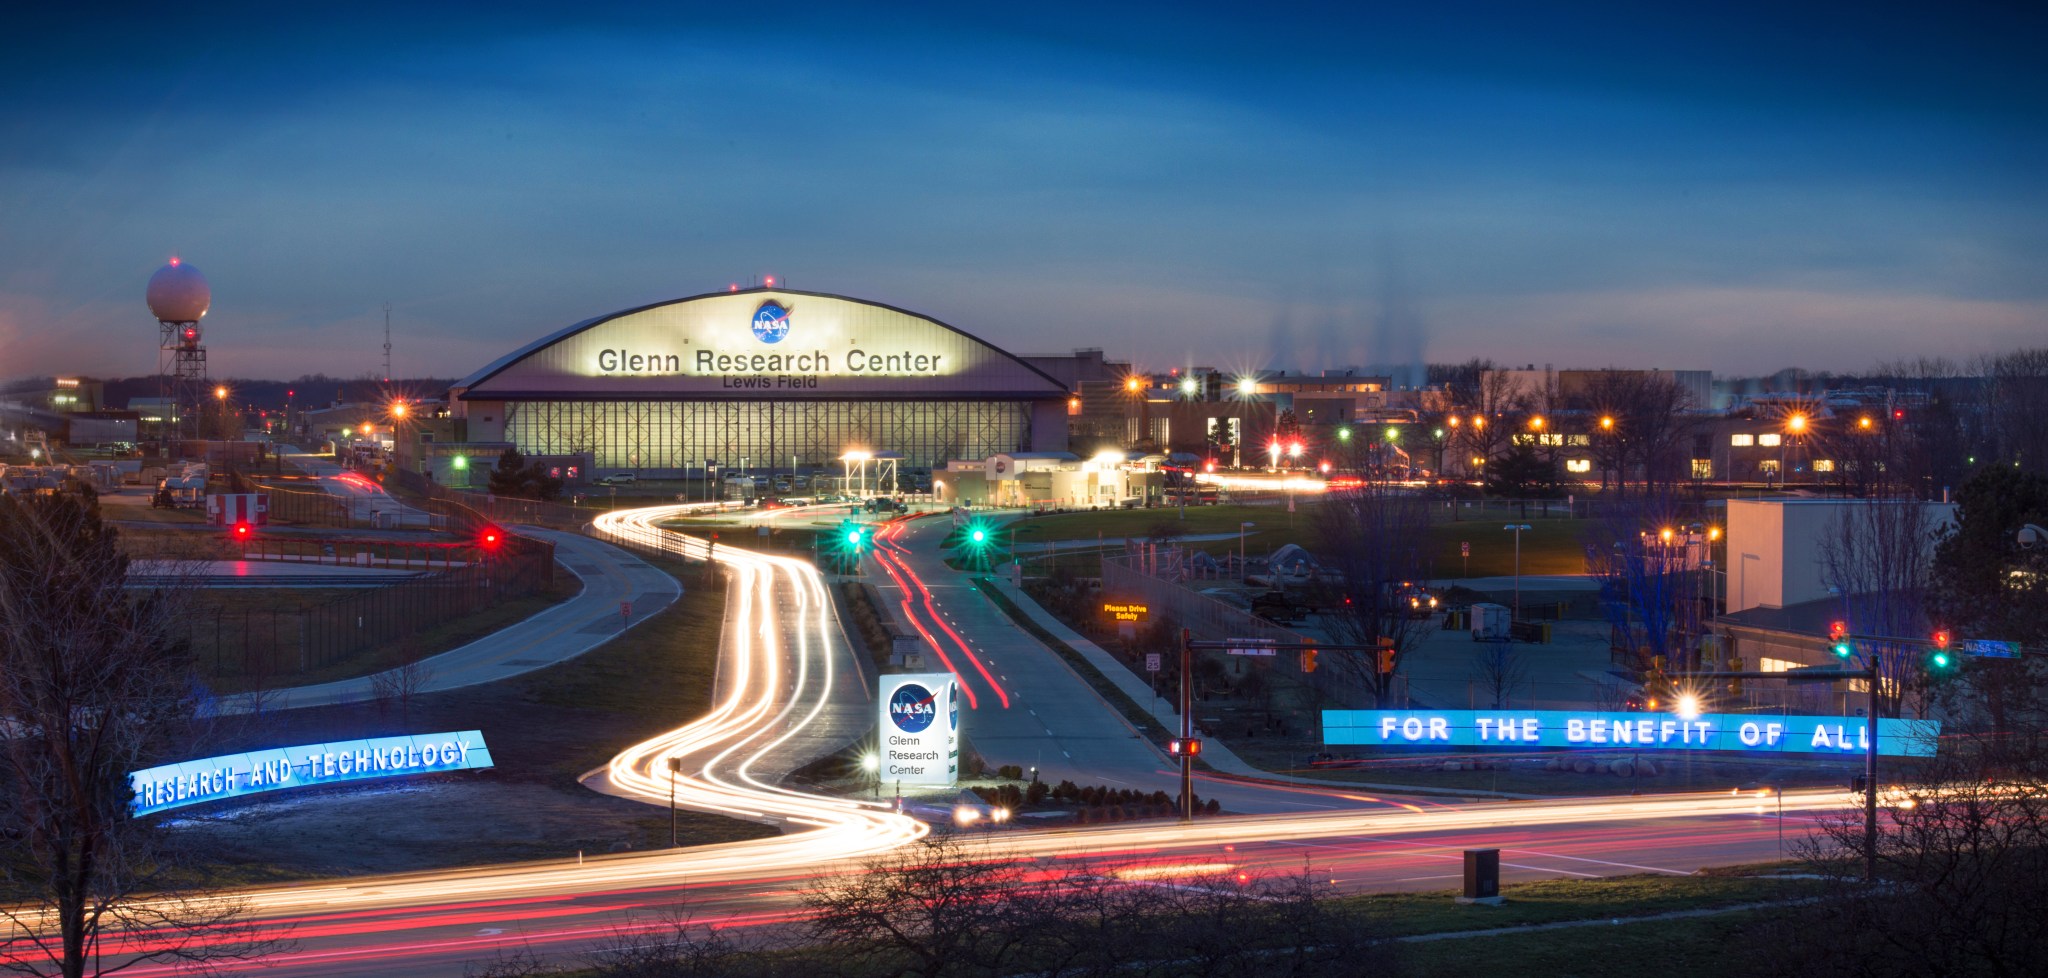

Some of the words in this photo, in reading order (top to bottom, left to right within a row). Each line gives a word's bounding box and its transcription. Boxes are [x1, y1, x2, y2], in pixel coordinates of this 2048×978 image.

[754, 320, 788, 330] NASA
[598, 348, 680, 372] Glenn
[696, 348, 830, 372] Research
[846, 348, 942, 372] Center
[723, 374, 771, 389] Lewis
[777, 374, 818, 389] Field
[1104, 604, 1127, 612] Please
[1116, 612, 1138, 621] Safely
[1965, 642, 1991, 653] NASA
[892, 702, 934, 714] NASA
[1381, 717, 1449, 740] FOR
[1476, 718, 1539, 741] THE
[1567, 719, 1711, 744] BENEFIT
[1740, 722, 1782, 746] OF
[888, 735, 920, 746] Glenn
[888, 750, 939, 760] Research
[144, 766, 235, 807] RESEARCH
[250, 758, 292, 787] AND
[308, 740, 471, 778] TECHNOLOGY
[889, 764, 925, 775] Center
